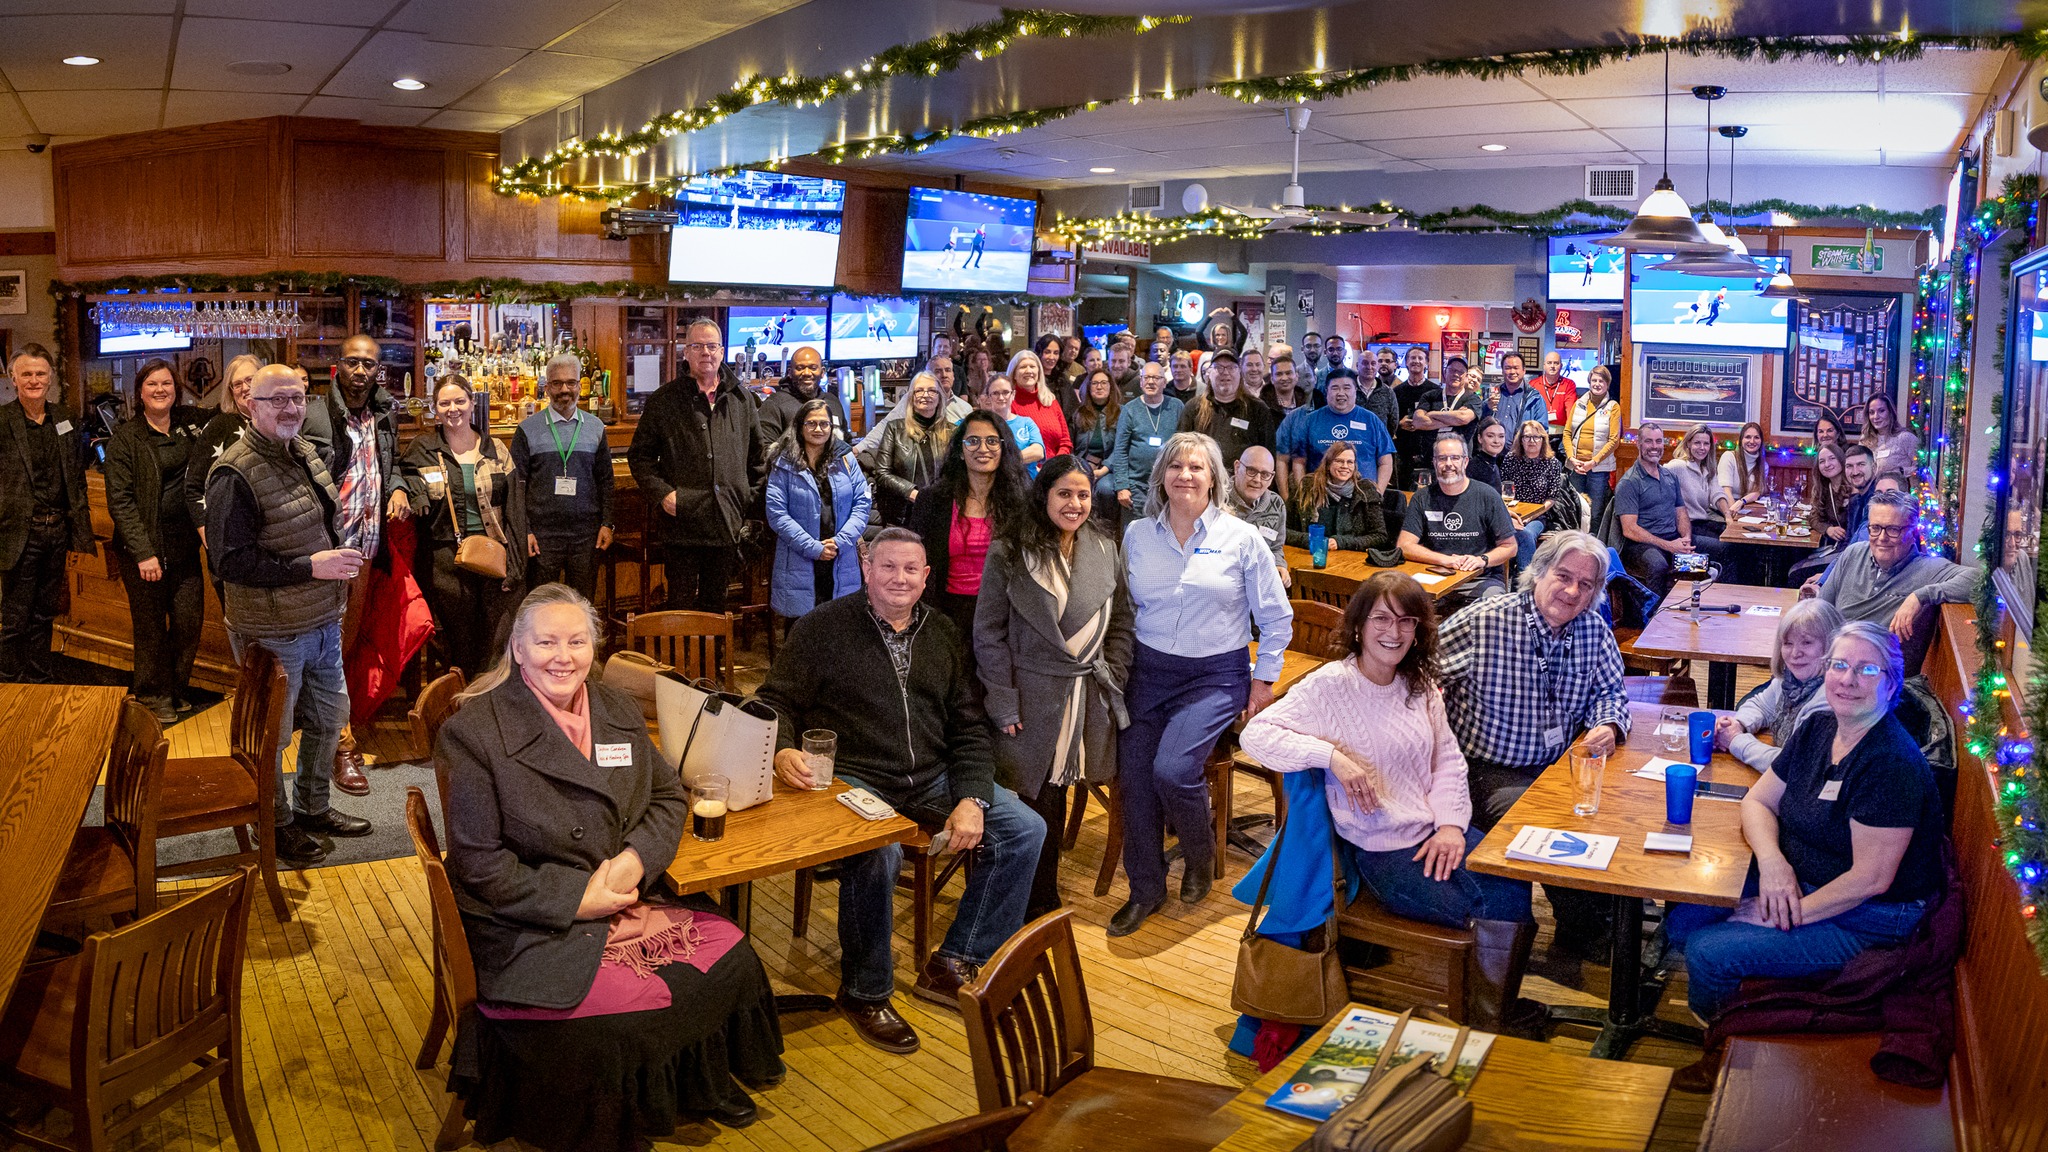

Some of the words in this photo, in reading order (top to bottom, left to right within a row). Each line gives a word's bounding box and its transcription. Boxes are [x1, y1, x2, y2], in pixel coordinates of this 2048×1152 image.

[1102, 239, 1149, 258] AVAILABLE
[1818, 249, 1843, 259] STEAM
[1821, 252, 1855, 267] WHISTLE
[1556, 311, 1570, 326] R
[1487, 345, 1496, 353] 87
[1525, 613, 1535, 628] ALL
[1564, 635, 1573, 650] ALL
[1537, 657, 1548, 672] ALL
[1420, 1029, 1481, 1045] TRUSD
